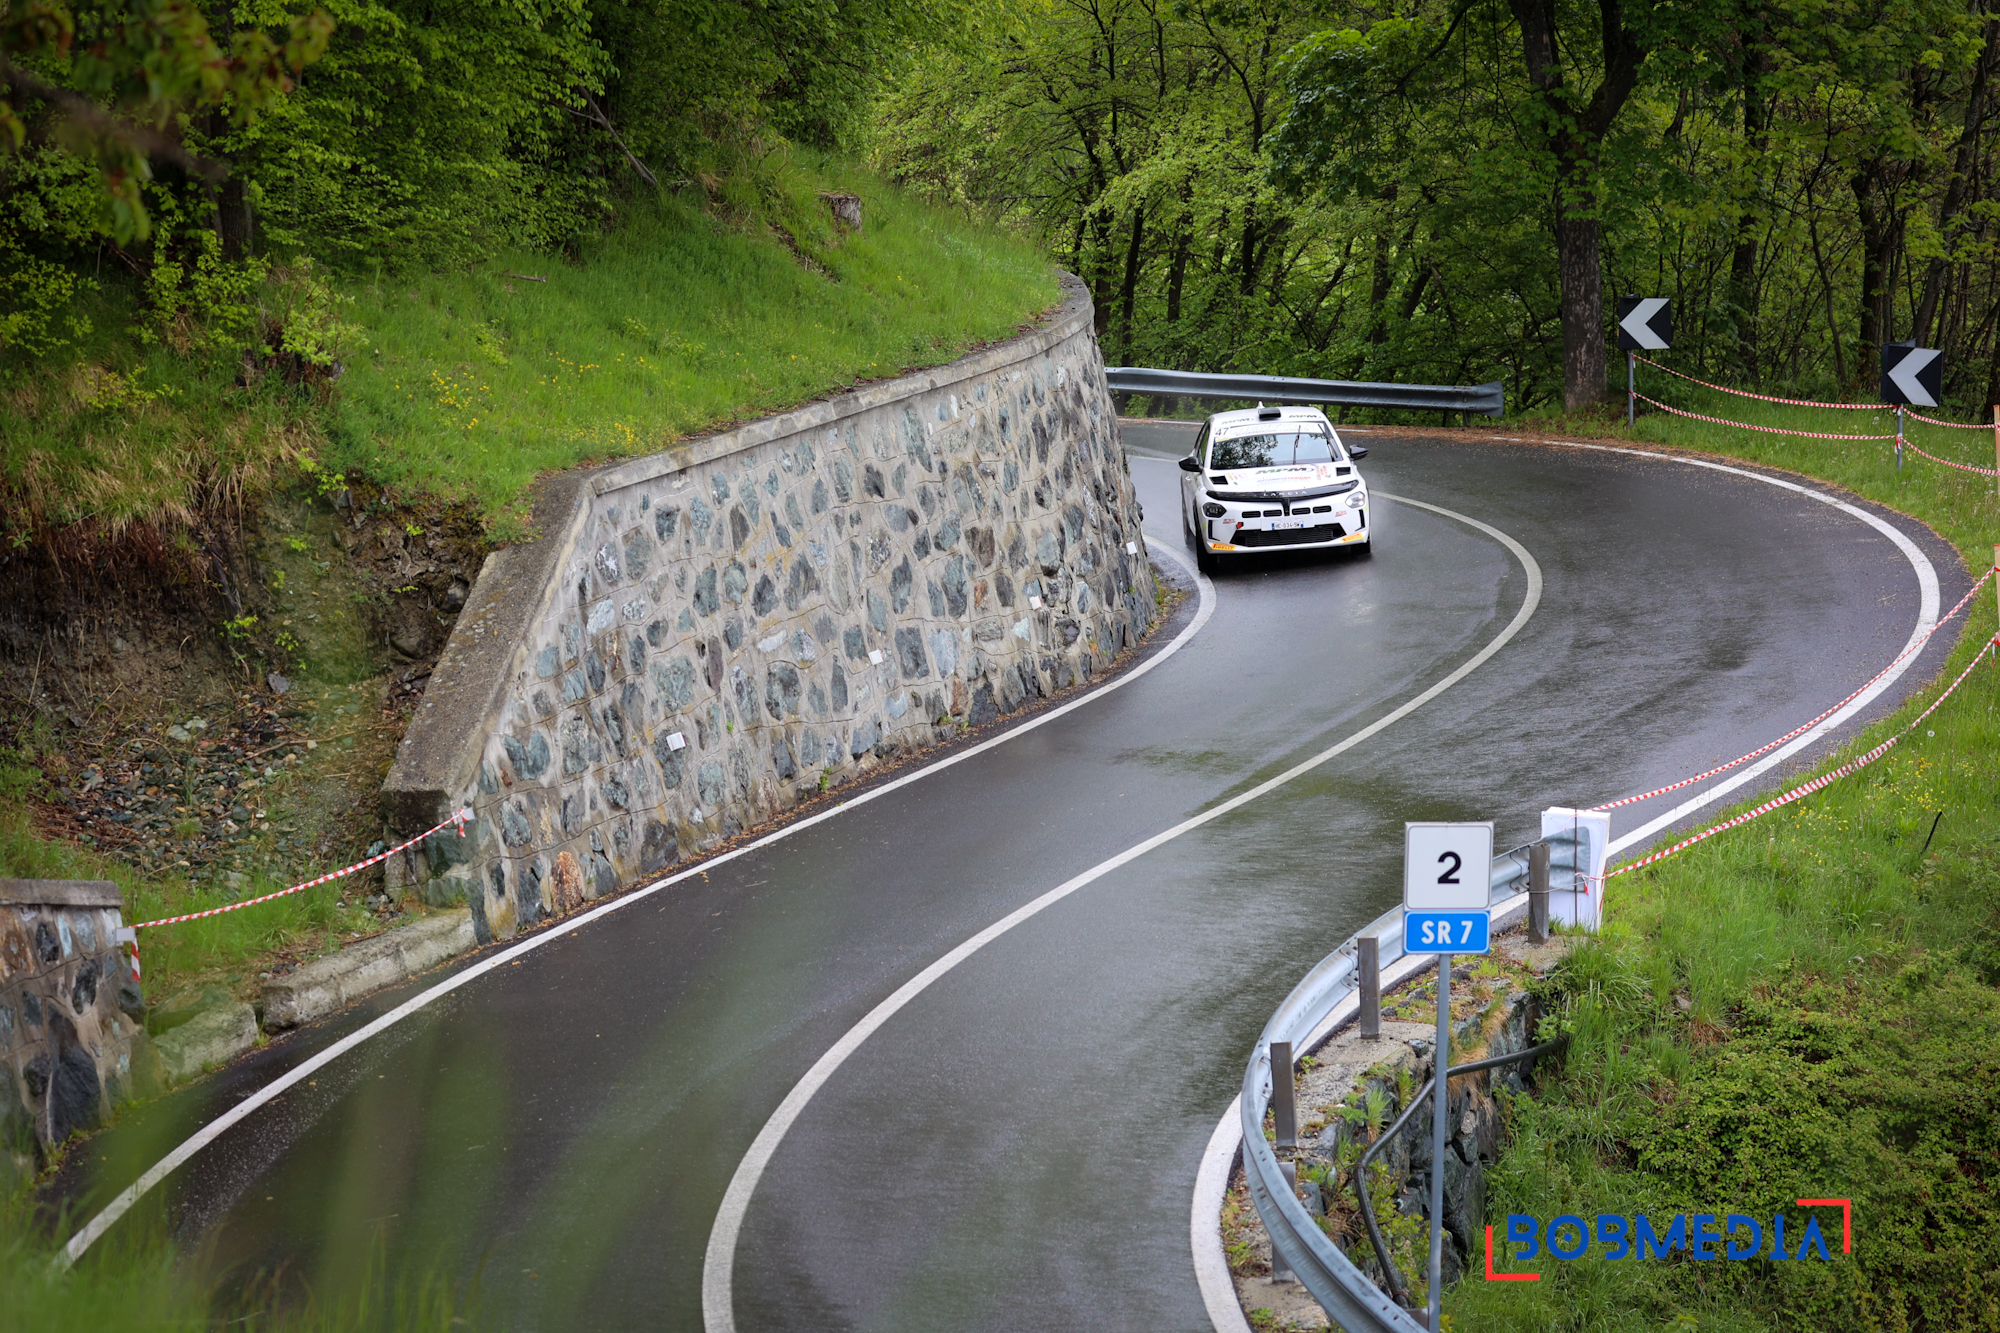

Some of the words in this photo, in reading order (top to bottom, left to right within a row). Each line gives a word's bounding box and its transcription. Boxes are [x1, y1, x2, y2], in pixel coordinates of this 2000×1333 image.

[1215, 427, 1230, 436] 47
[1437, 851, 1462, 884] 2
[1421, 920, 1452, 945] SR
[1460, 920, 1473, 944] 7
